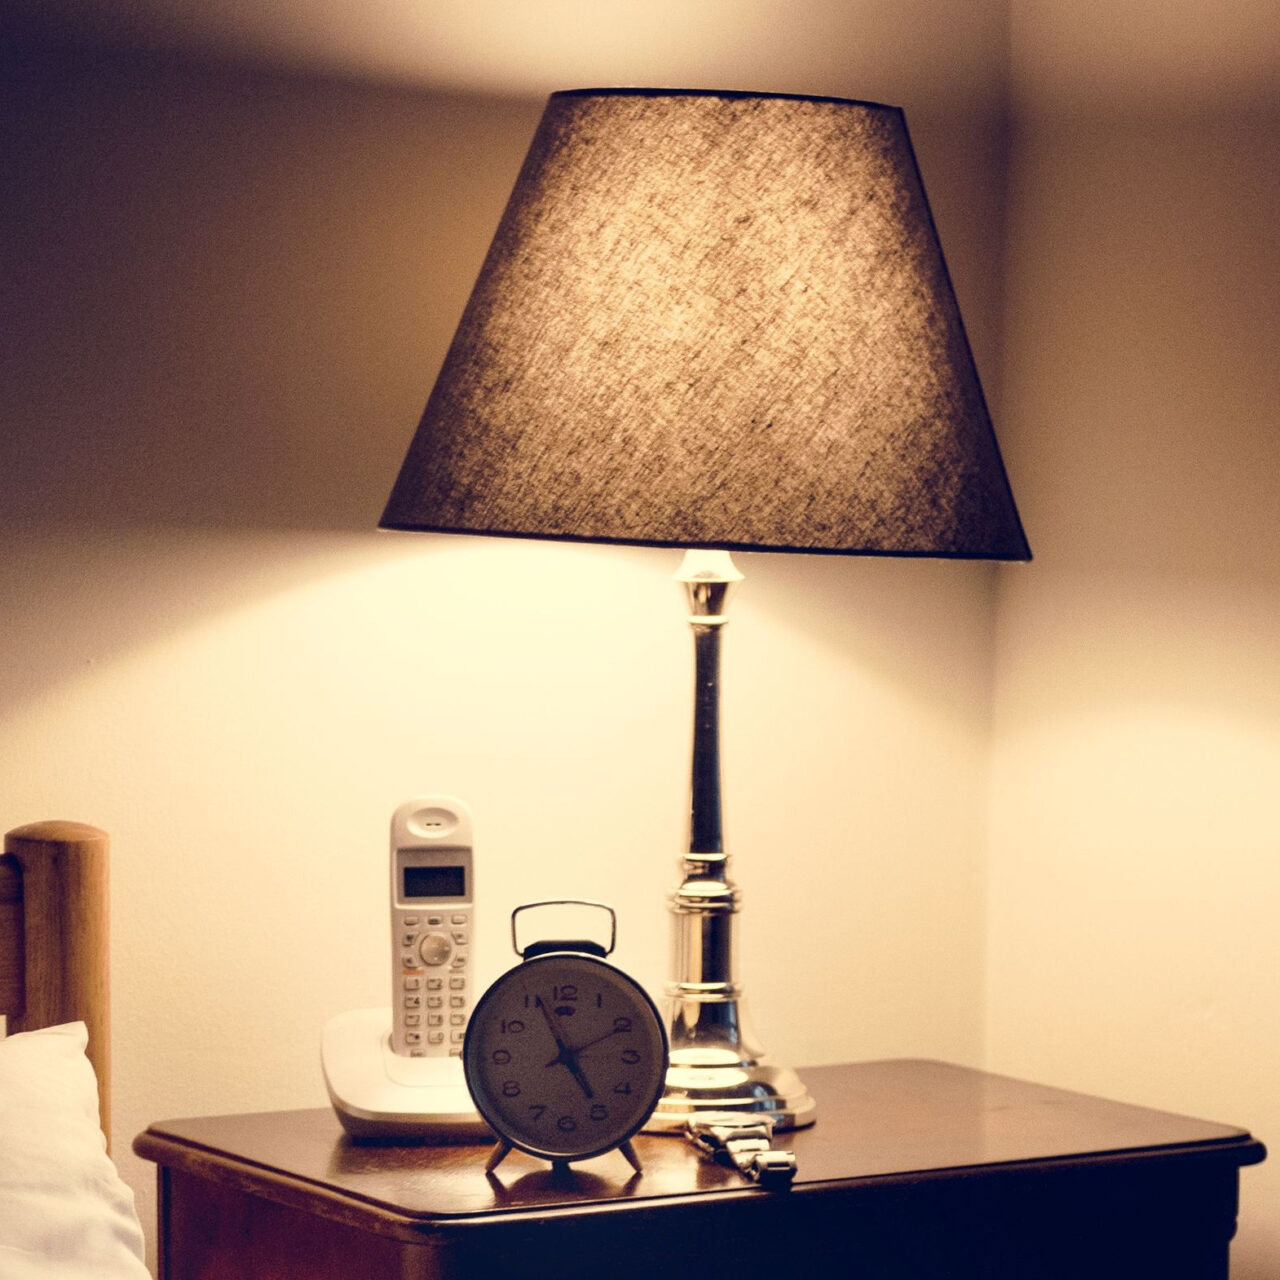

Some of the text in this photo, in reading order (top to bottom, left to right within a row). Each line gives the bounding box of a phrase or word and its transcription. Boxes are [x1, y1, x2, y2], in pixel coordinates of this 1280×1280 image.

[553, 985, 578, 1001] 12
[597, 993, 602, 1008] 1
[501, 1019, 525, 1033] 10
[613, 1017, 631, 1032] 2
[492, 1049, 511, 1065] 9
[621, 1050, 640, 1064] 3
[503, 1080, 521, 1097] 8
[614, 1082, 632, 1095] 4
[529, 1105, 547, 1122] 7
[590, 1104, 607, 1120] 5
[557, 1116, 577, 1131] 6
